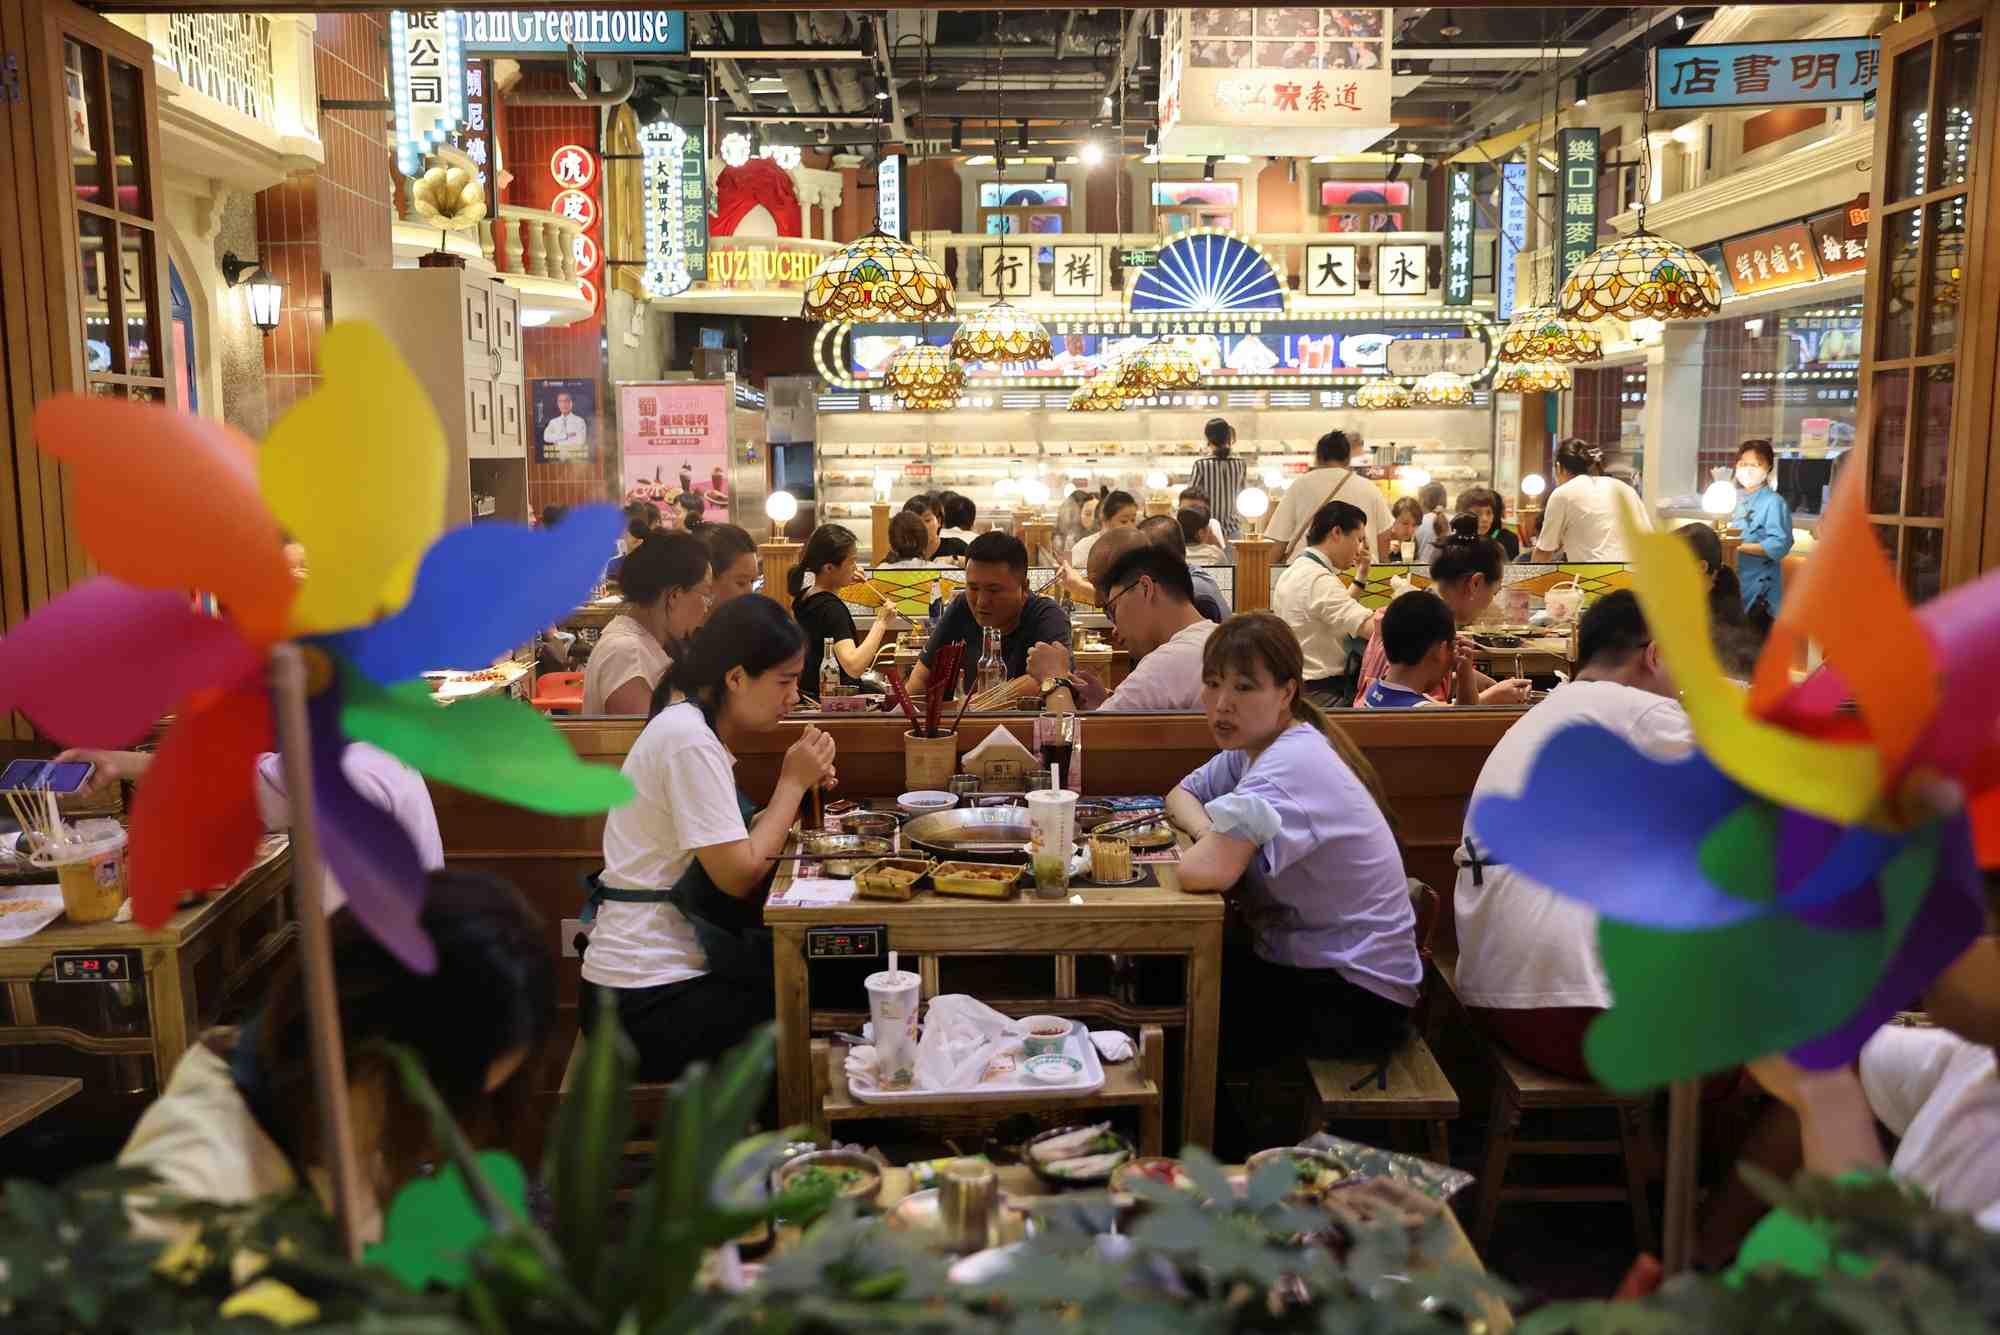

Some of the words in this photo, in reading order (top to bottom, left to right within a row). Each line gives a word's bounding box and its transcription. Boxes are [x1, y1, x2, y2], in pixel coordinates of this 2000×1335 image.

[709, 251, 829, 282] HUZHUCHU
[991, 253, 1023, 289] 行
[1063, 252, 1095, 288] 祥
[1316, 252, 1348, 288] 大
[1389, 251, 1420, 288] 永
